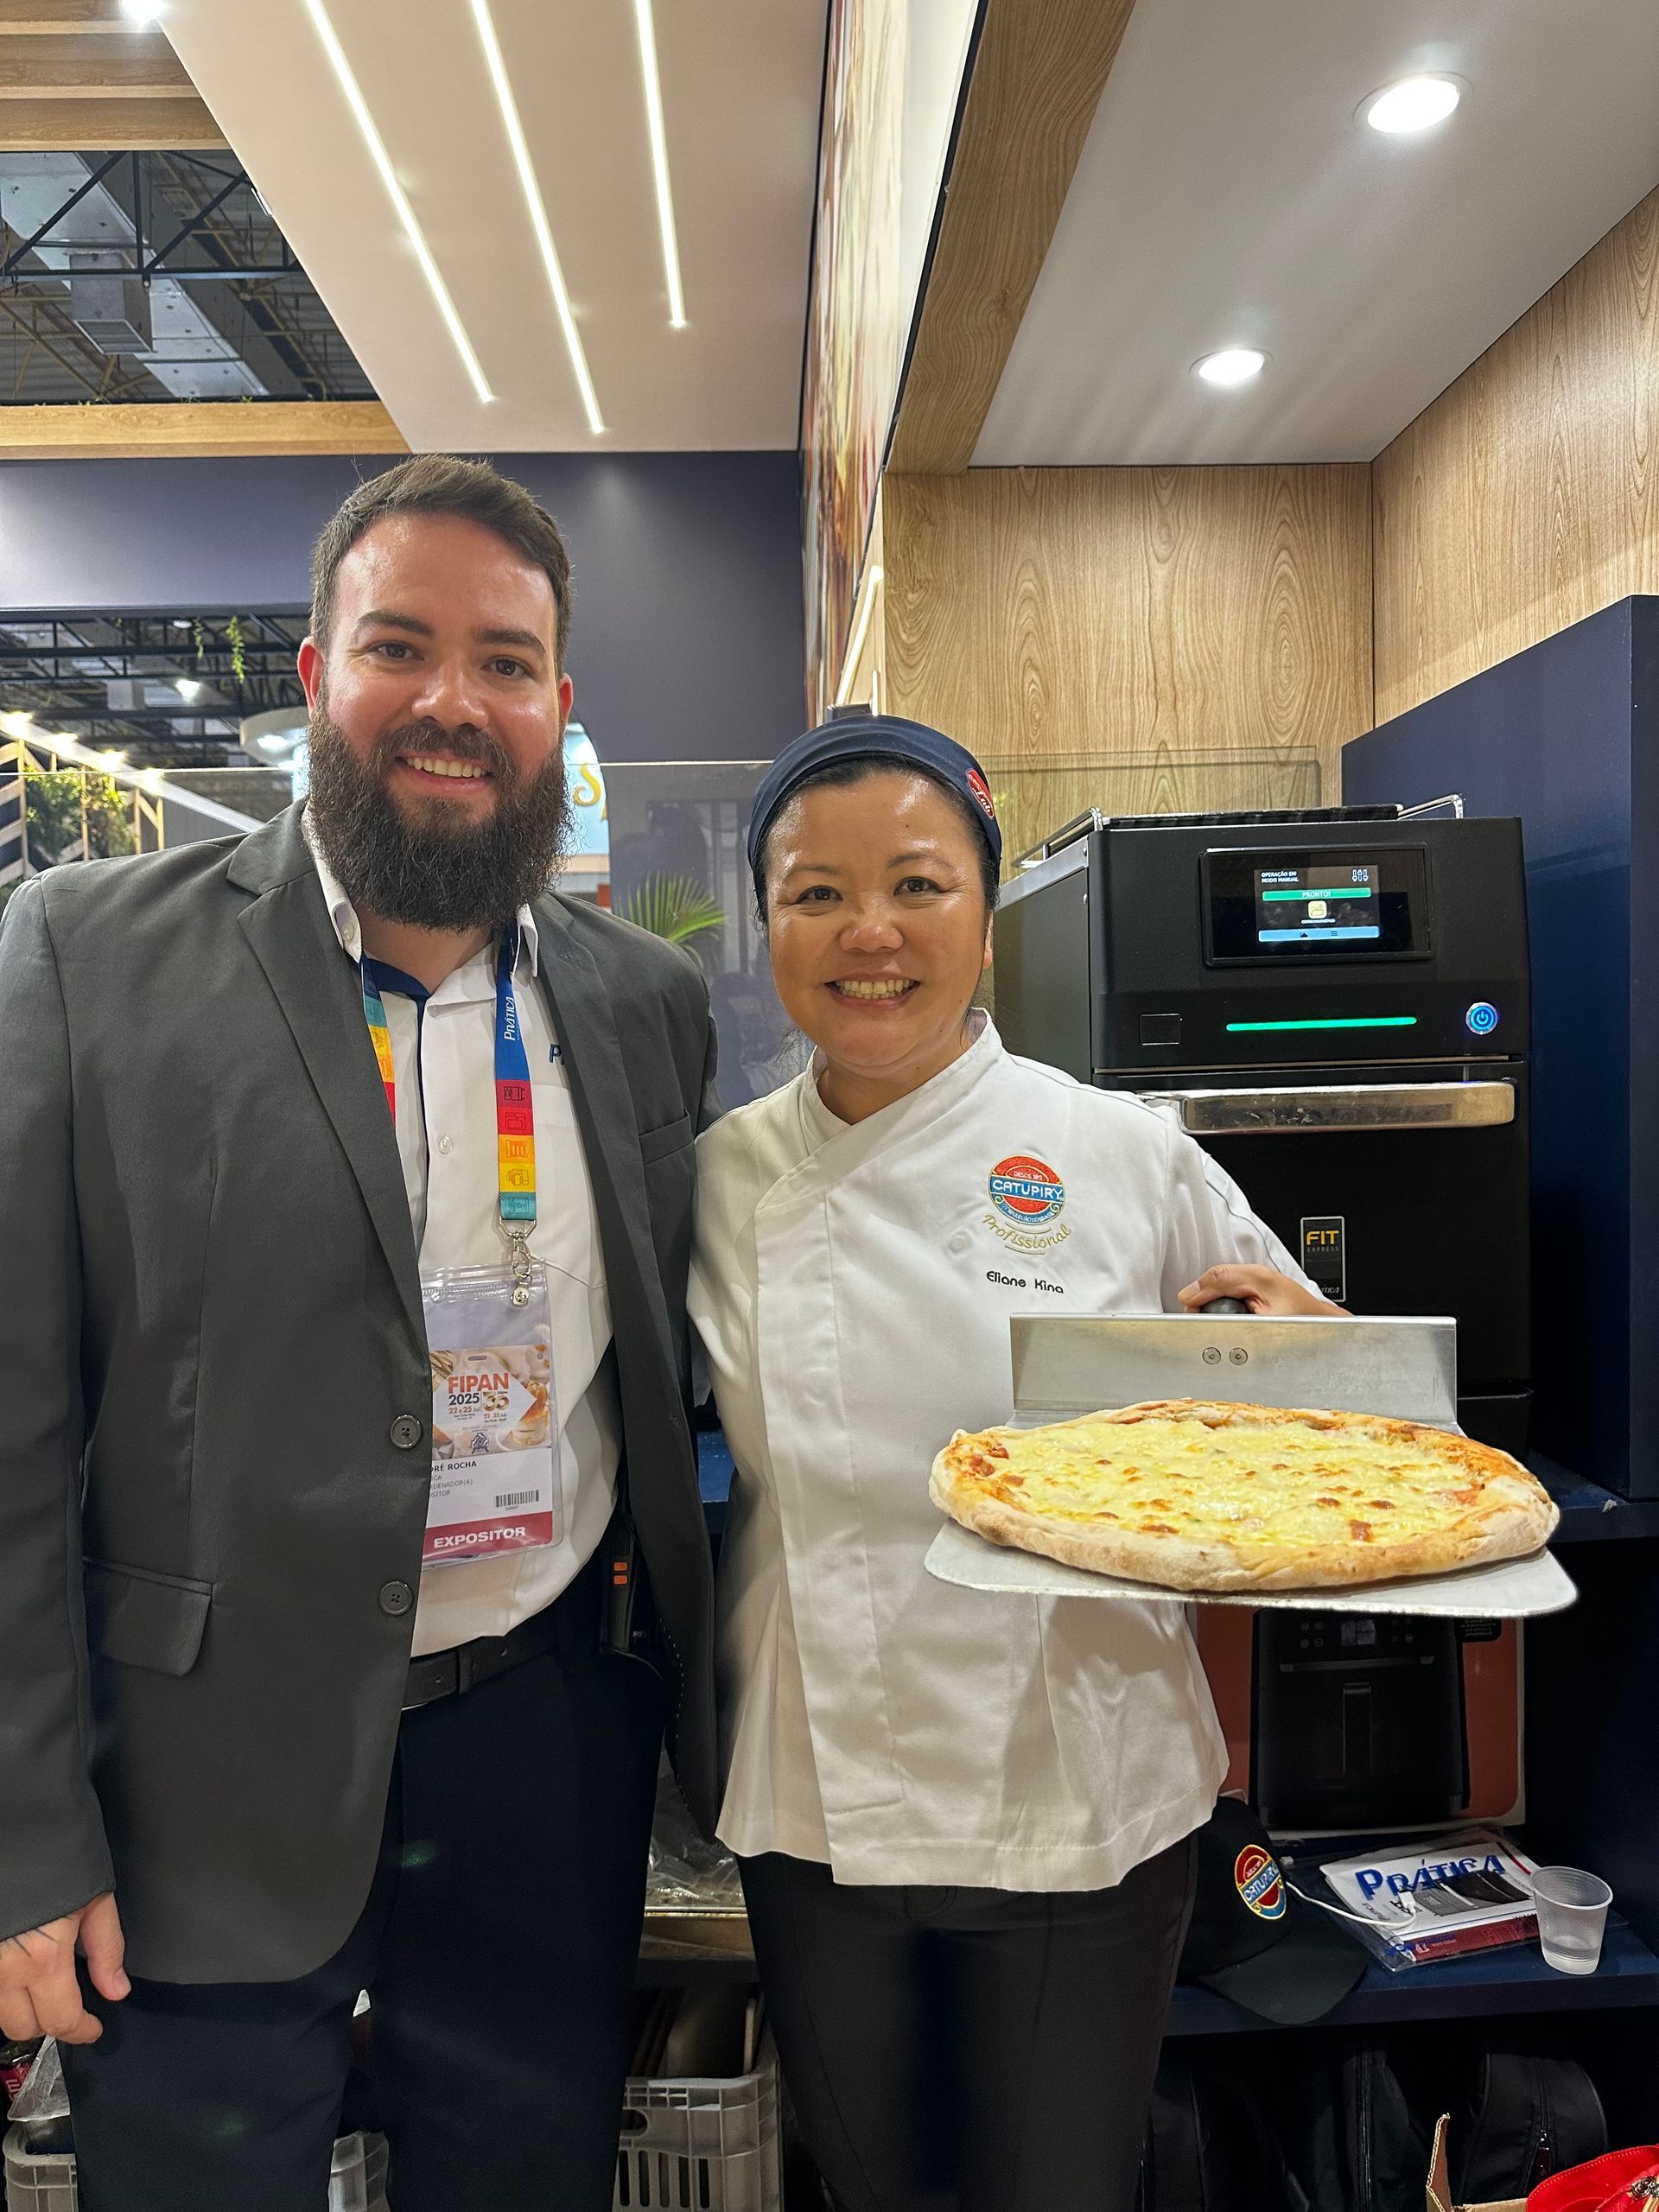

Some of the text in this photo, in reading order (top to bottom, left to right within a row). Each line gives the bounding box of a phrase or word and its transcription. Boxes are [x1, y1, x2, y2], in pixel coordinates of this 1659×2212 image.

[993, 1179, 1064, 1199] CATUPIRY
[982, 1214, 1071, 1249] Profissional
[1306, 1230, 1339, 1244] FIT
[986, 1271, 1064, 1294] Eliane Kina
[448, 1372, 509, 1394] FIPAN
[448, 1392, 480, 1406] 2025
[448, 1460, 477, 1471] ROCHA
[434, 1526, 526, 1548] EXPOSITOR
